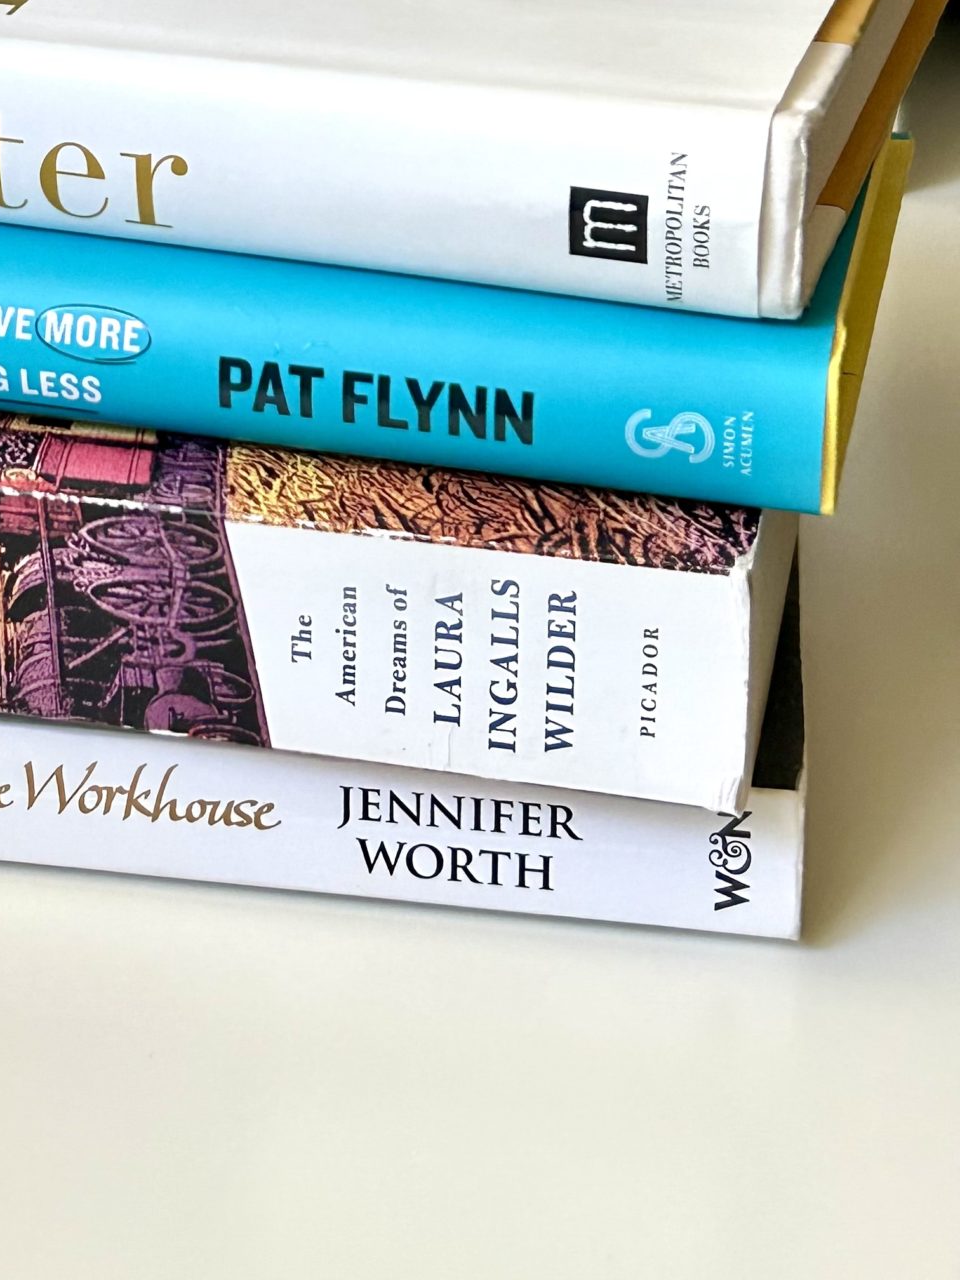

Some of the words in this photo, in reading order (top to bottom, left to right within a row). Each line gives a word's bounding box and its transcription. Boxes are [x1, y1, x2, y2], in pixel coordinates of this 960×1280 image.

[664, 152, 689, 303] METROPOLITAN
[692, 205, 711, 269] BOOKS
[44, 311, 144, 353] MORE
[21, 368, 102, 403] LESS
[218, 356, 325, 418] PAT
[342, 370, 535, 445] FLYNN
[722, 416, 737, 468] SIMON
[740, 411, 754, 476] ACUMEN
[386, 584, 408, 611] of
[291, 614, 313, 663] The
[335, 585, 357, 707] American
[385, 620, 407, 716] Dreams
[433, 591, 464, 728] LAURA
[488, 578, 521, 753] INGALLS
[544, 590, 578, 753] WILDER
[640, 627, 659, 738] PICADOR
[23, 760, 282, 831] Workhouse
[337, 785, 583, 840] JENNIFER
[356, 837, 555, 891] WORTH
